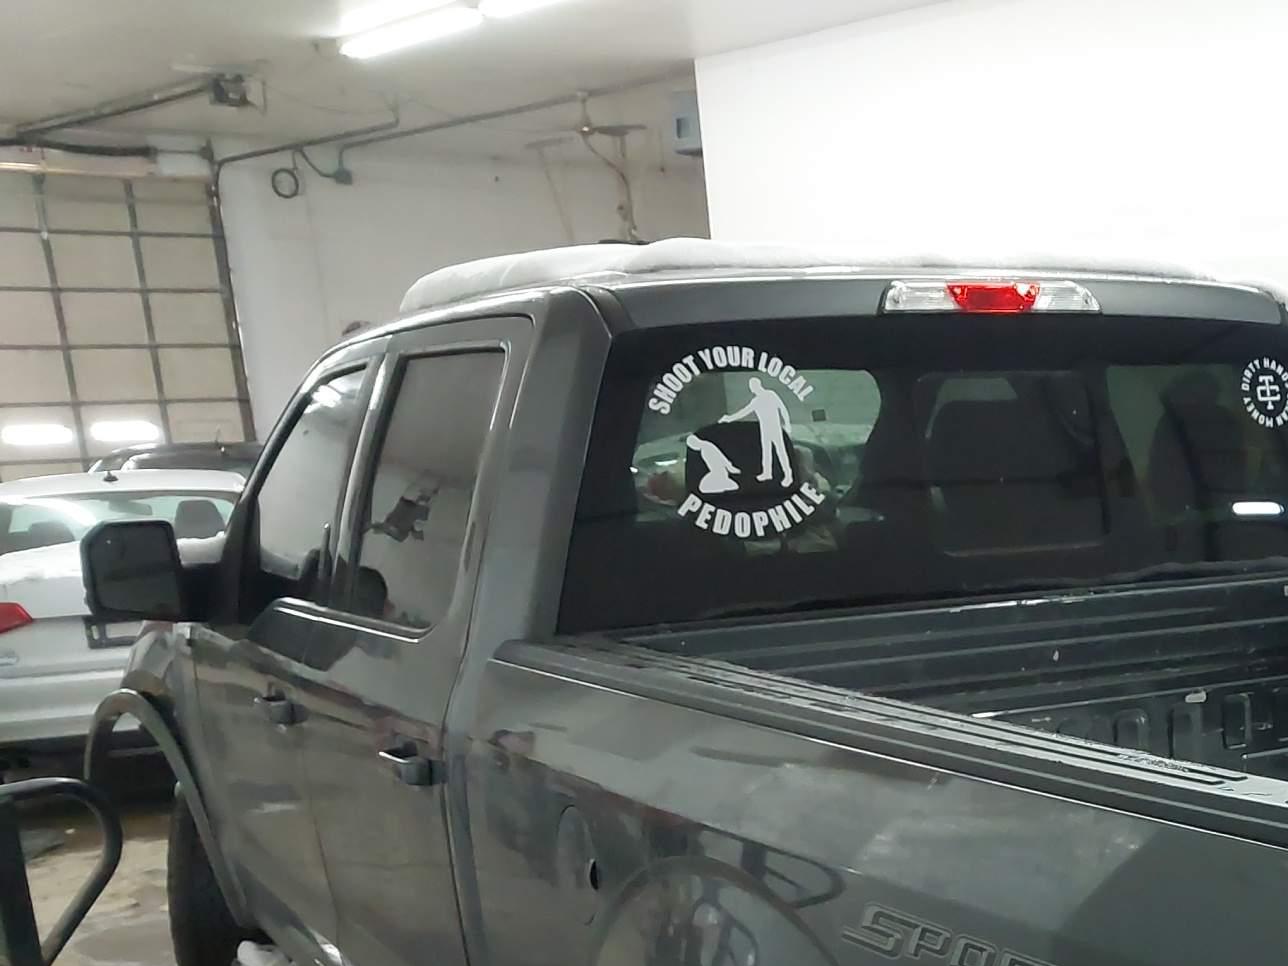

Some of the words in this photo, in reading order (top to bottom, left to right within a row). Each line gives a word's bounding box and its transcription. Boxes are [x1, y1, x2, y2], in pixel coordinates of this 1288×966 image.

[649, 356, 703, 415] SHOOT
[698, 346, 755, 371] YOUR
[758, 352, 815, 401] LOCAL
[1241, 359, 1261, 391] DIRTY
[1243, 397, 1273, 428] MONEY
[678, 482, 825, 538] PEDOPHILE
